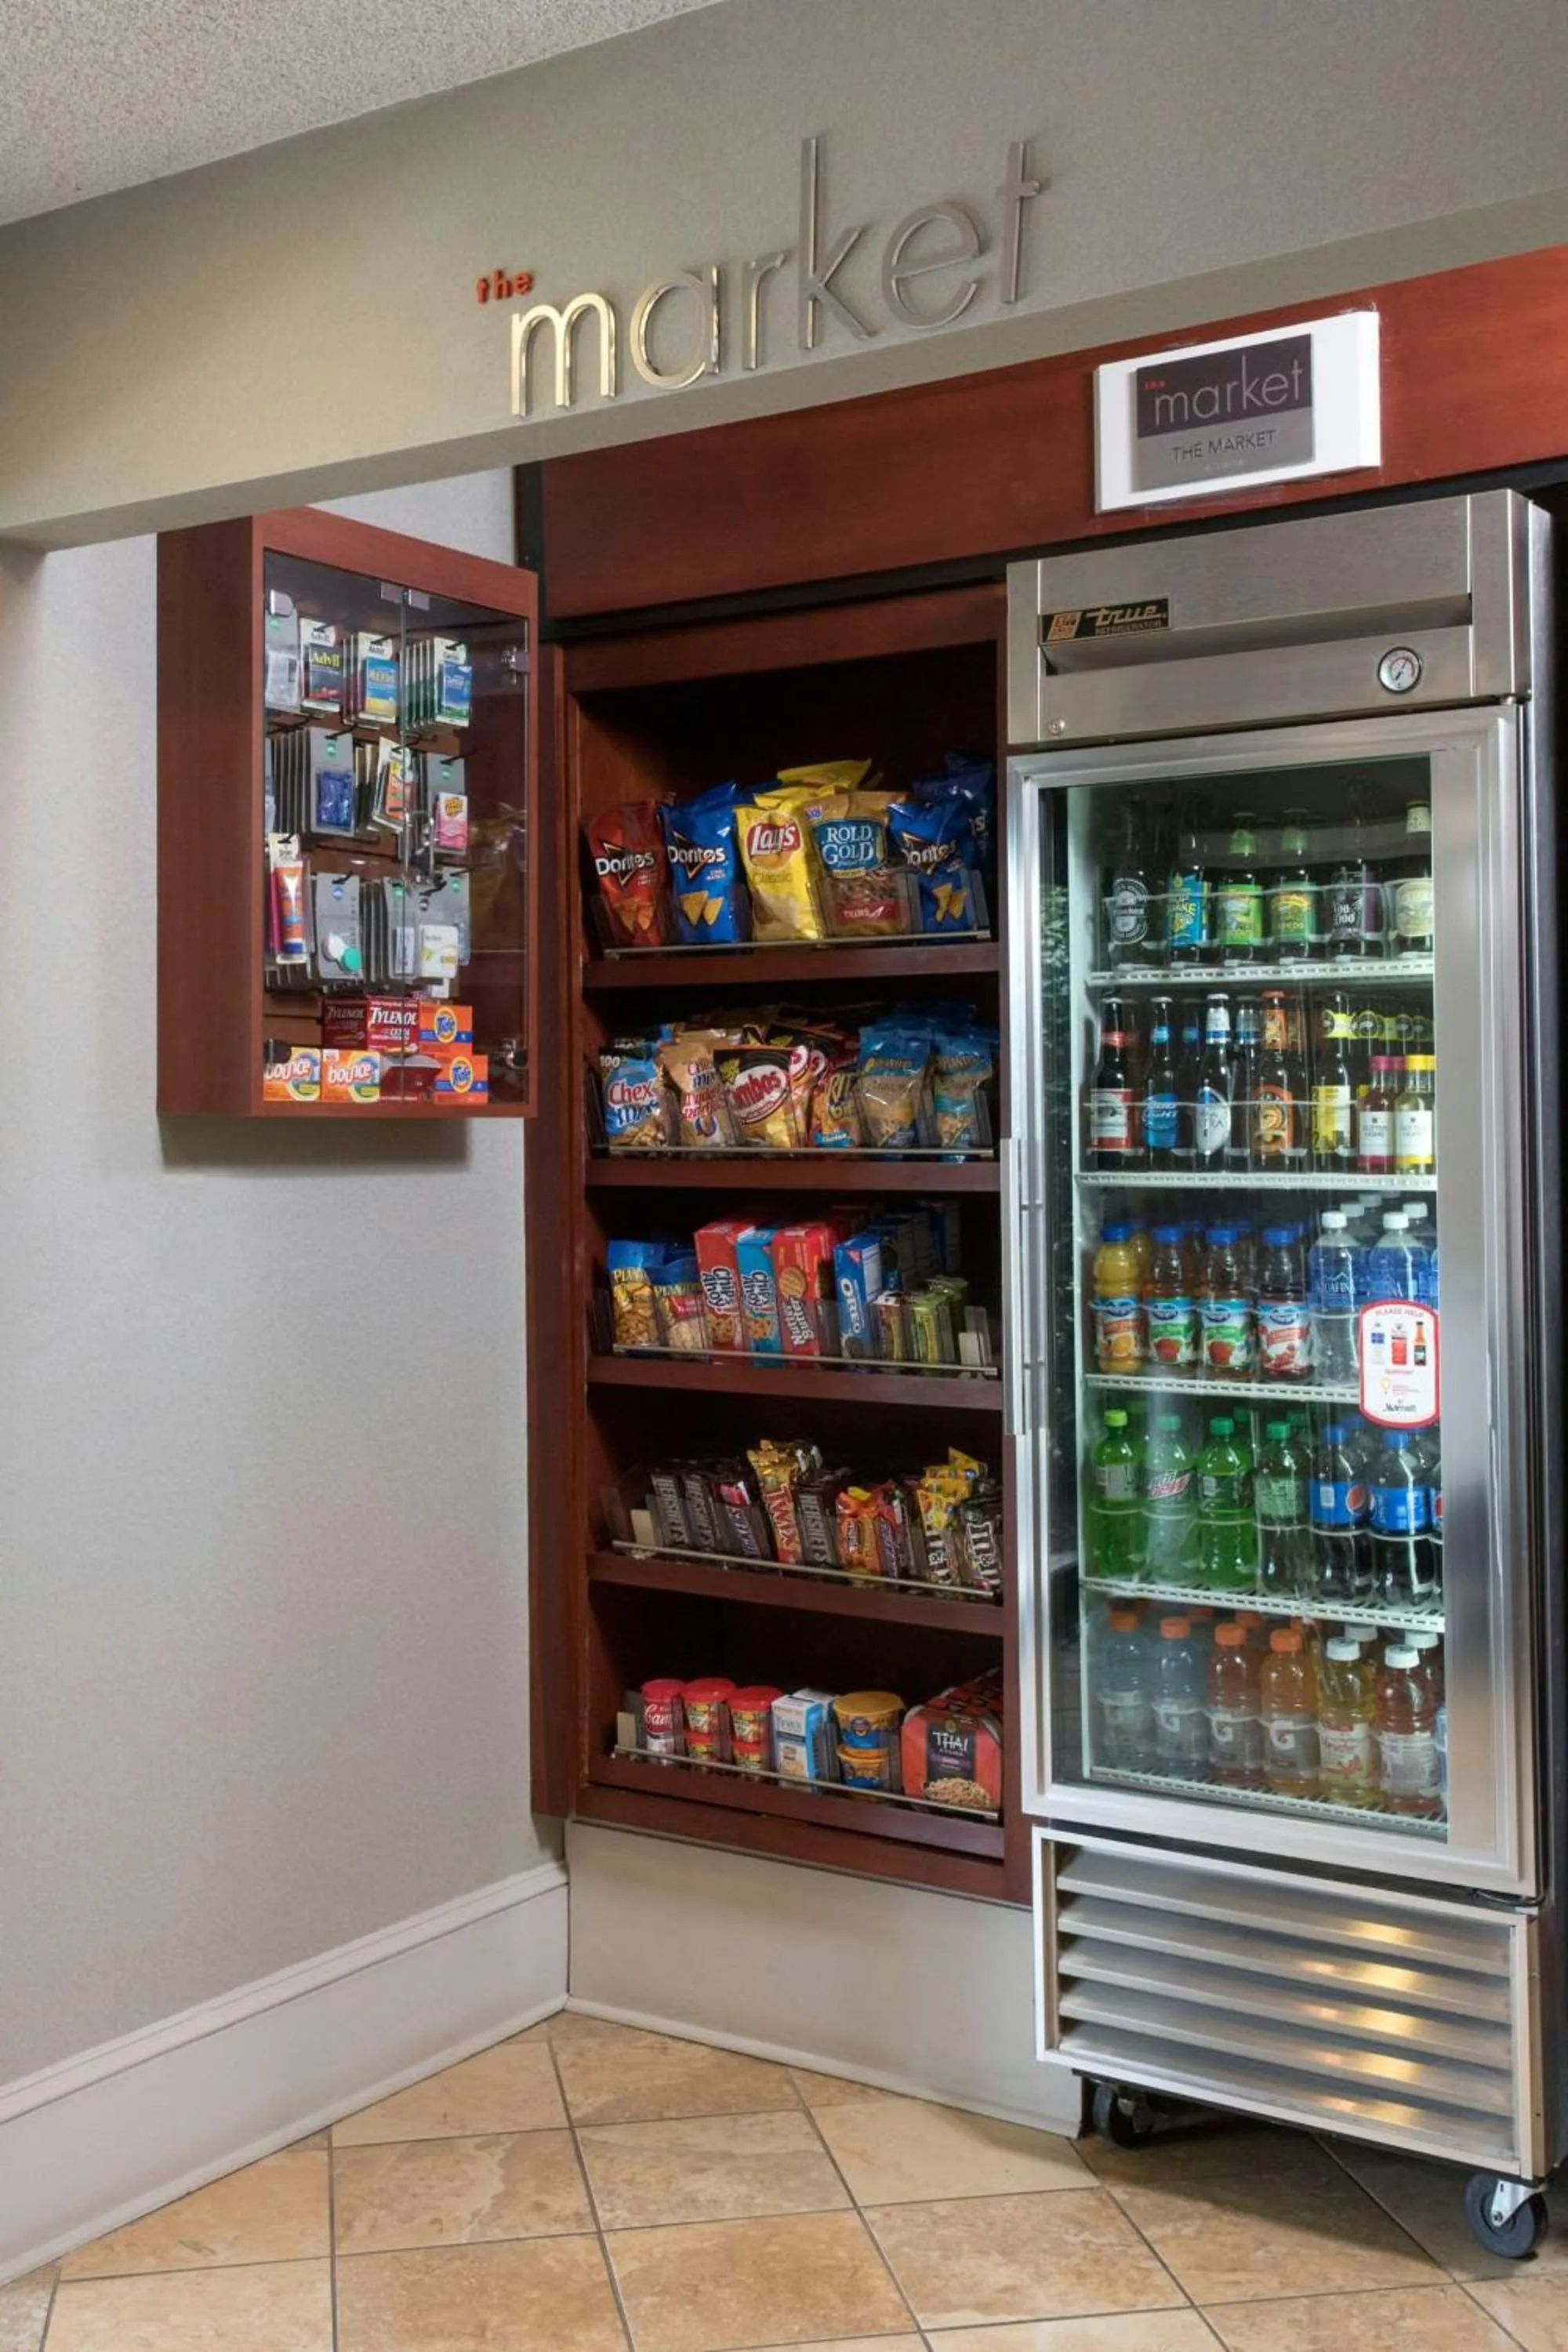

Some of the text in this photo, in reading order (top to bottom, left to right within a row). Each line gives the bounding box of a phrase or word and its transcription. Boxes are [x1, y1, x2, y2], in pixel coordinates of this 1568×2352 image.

[477, 267, 533, 303] the
[510, 136, 1051, 417] market
[1154, 353, 1304, 426] market
[1172, 429, 1277, 461] THE MARKET
[313, 652, 339, 668] Advil
[826, 826, 873, 843] ROLD
[667, 847, 726, 864] Doritos
[822, 841, 874, 865] GOLD
[595, 851, 655, 877] Doritos
[370, 1006, 418, 1025] TYLENOL
[434, 1015, 456, 1033] Tide
[264, 1060, 311, 1080] bounce
[601, 1055, 620, 1068] 100
[328, 1063, 373, 1083] bounce
[450, 1064, 472, 1085] Tide
[608, 1079, 653, 1107] Chex
[840, 1277, 862, 1334] OREO
[932, 1730, 968, 1751] THAI
